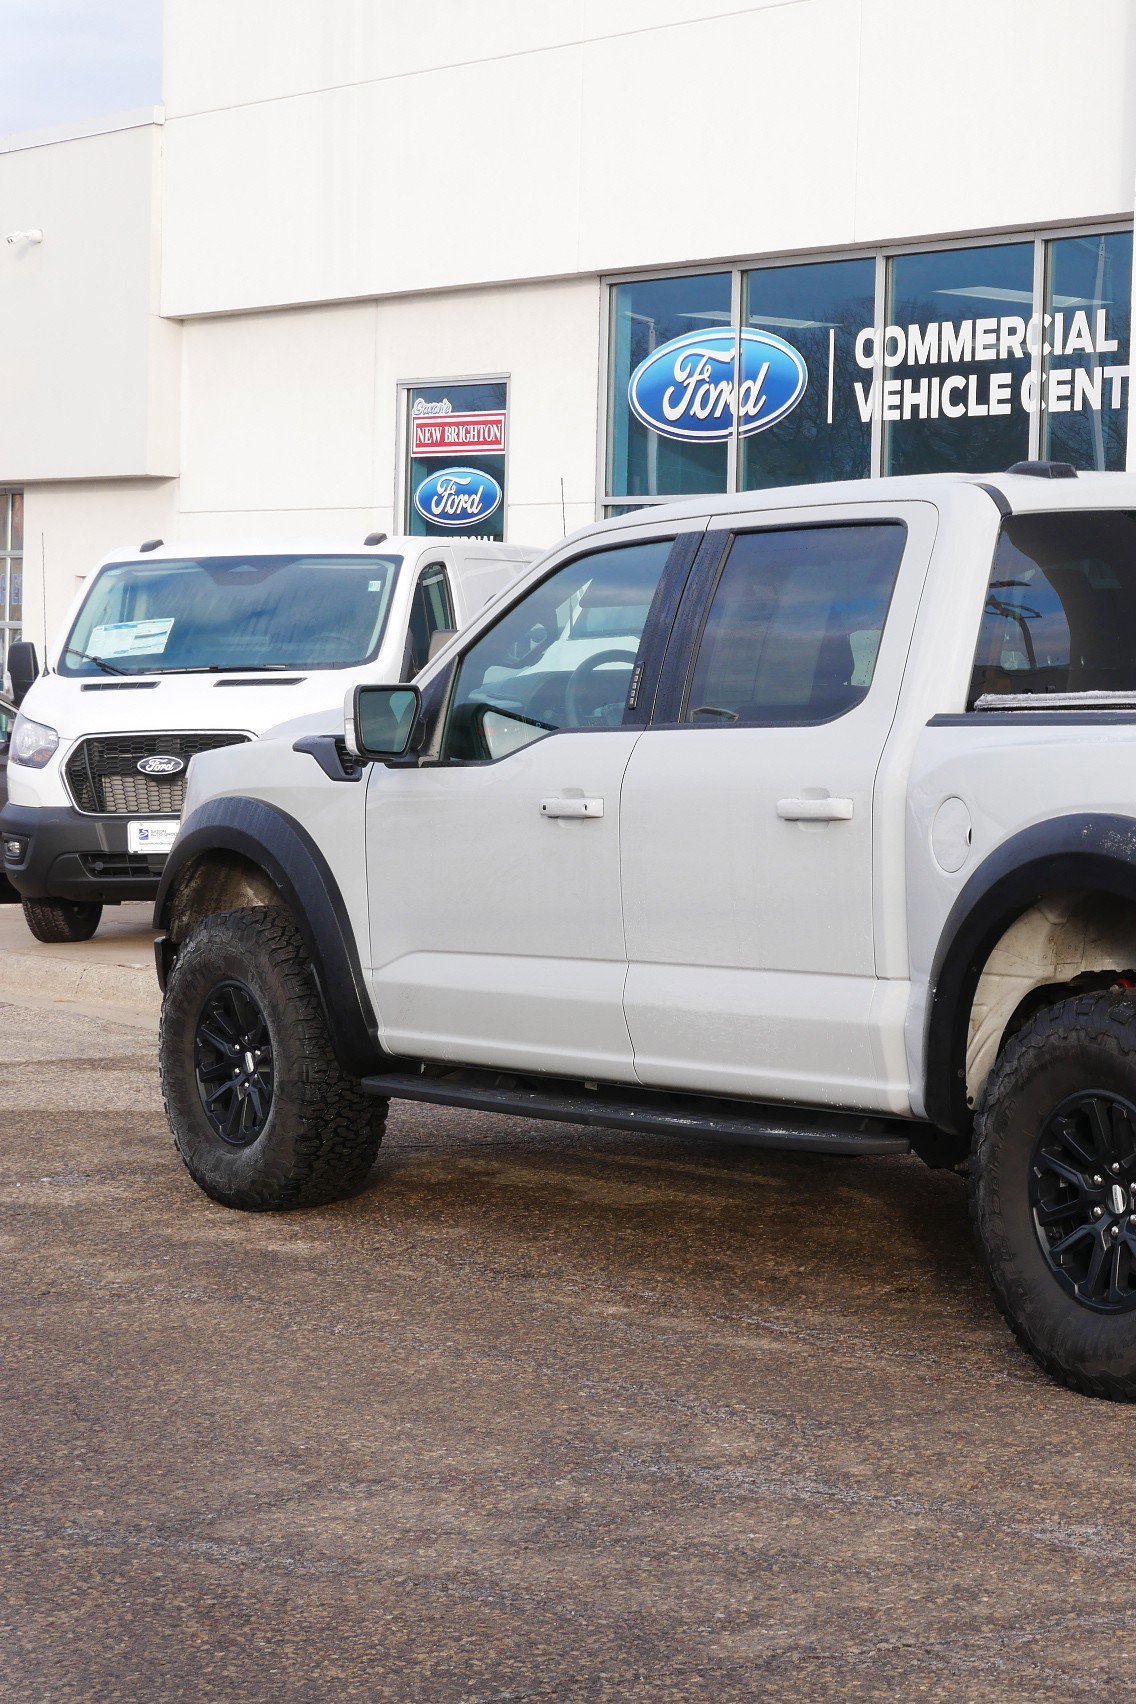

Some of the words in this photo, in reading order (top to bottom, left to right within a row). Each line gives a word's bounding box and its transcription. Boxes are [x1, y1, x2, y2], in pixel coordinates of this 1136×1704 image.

[854, 308, 1118, 369] COMMERCIAL
[662, 347, 770, 422] Ford
[853, 373, 1012, 423] VEHICLE
[416, 427, 442, 444] NEW
[444, 423, 501, 443] BRIGHTON
[431, 476, 484, 514] Ford
[146, 759, 174, 771] Ford
